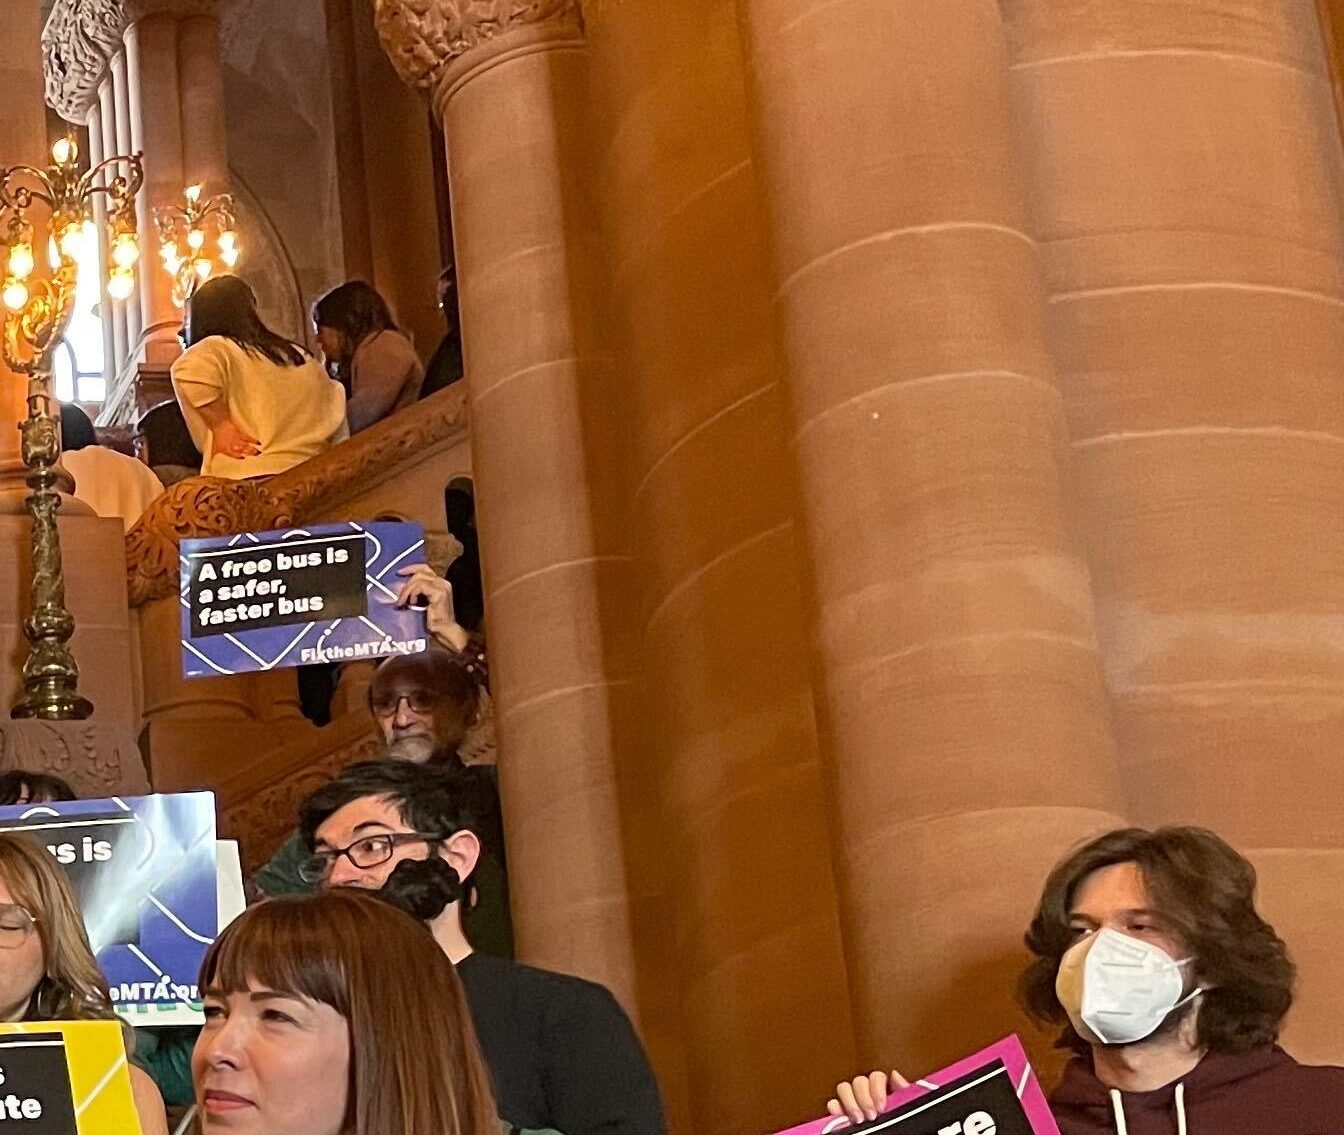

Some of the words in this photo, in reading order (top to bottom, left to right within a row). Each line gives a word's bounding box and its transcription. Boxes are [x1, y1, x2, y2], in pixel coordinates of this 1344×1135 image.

[198, 563, 217, 582] A
[221, 557, 272, 579] free
[276, 552, 322, 571] bus
[326, 546, 348, 565] is
[198, 586, 214, 604] a
[216, 577, 287, 602] safer,
[198, 602, 275, 627] faster
[278, 594, 324, 615] bus
[301, 638, 426, 663] FixtheMTA.org
[82, 836, 113, 862] is
